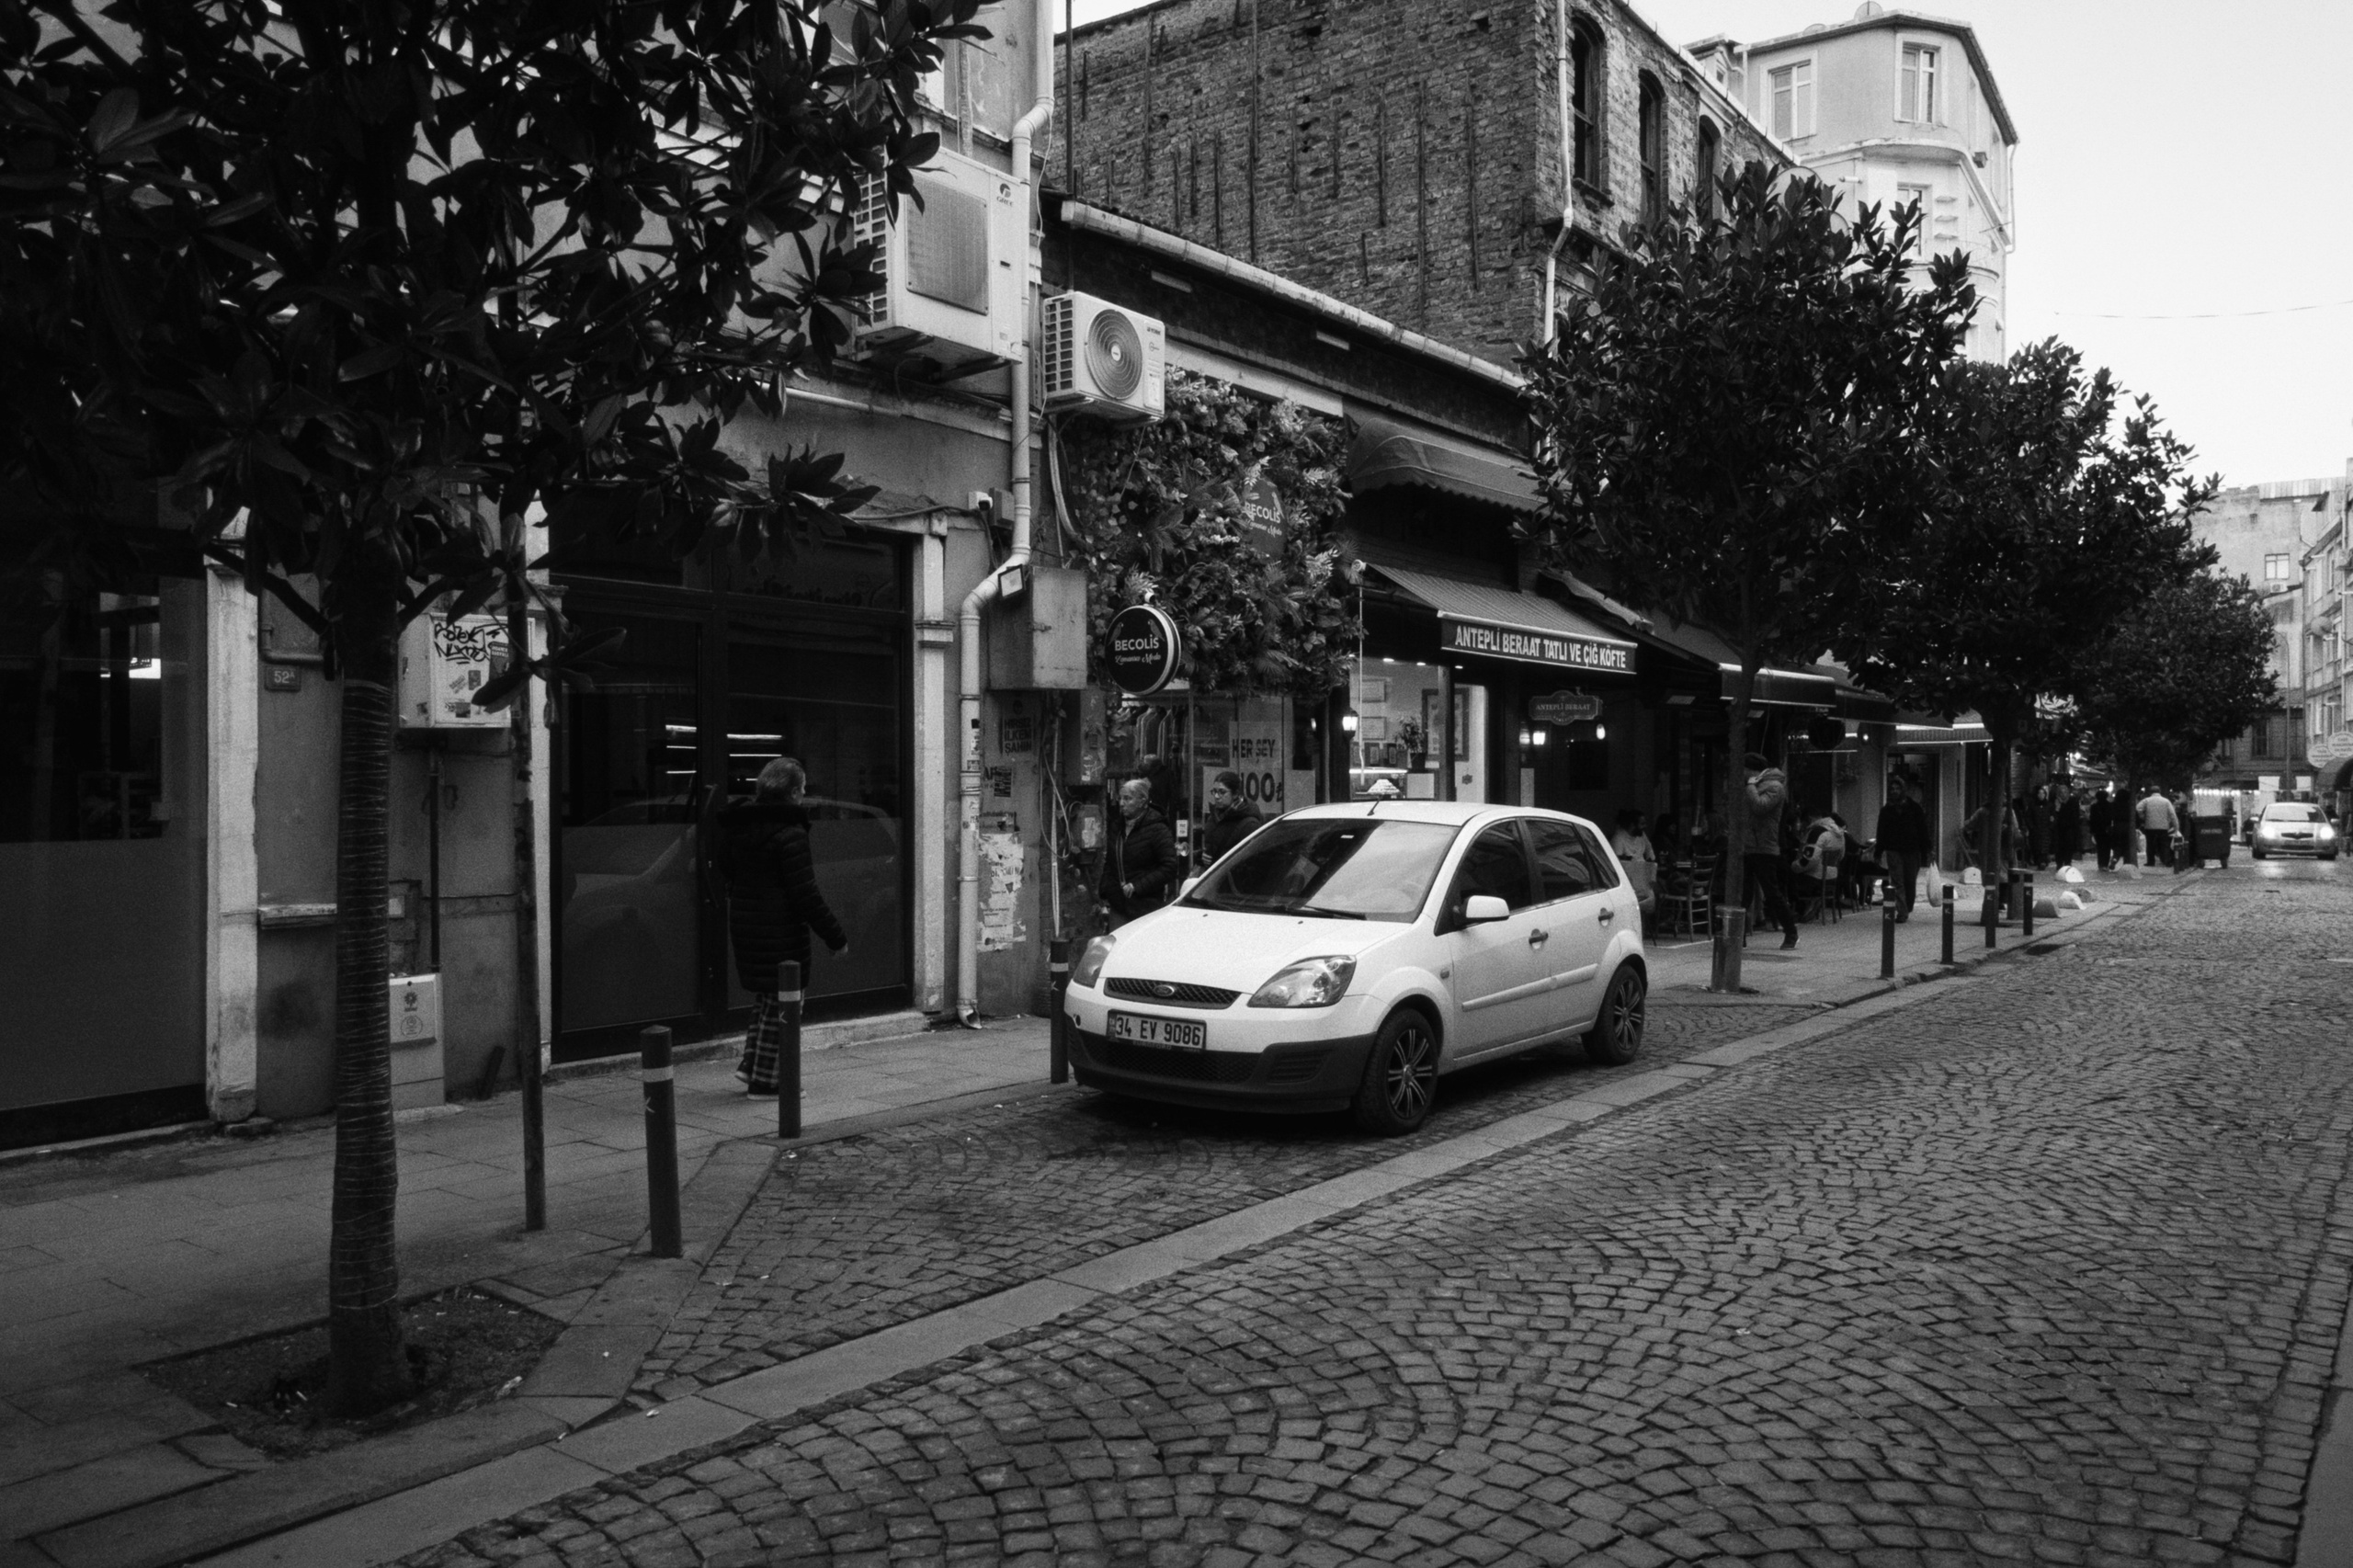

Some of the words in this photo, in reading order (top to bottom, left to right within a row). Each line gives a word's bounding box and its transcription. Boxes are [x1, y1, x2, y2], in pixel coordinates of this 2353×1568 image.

[1115, 634, 1160, 652] BECOLİS
[1455, 626, 1500, 652] ANTEPLİ
[1503, 632, 1540, 657] BERAAT
[1543, 639, 1567, 661] TATLI
[1569, 642, 1582, 663] VE
[1583, 642, 1598, 668] ÇİĞ
[1599, 643, 1626, 670] KÖFTE
[1232, 738, 1253, 758] HER
[1116, 1017, 1131, 1037] 34
[1140, 1019, 1157, 1040] EV
[1164, 1023, 1201, 1046] 9086
